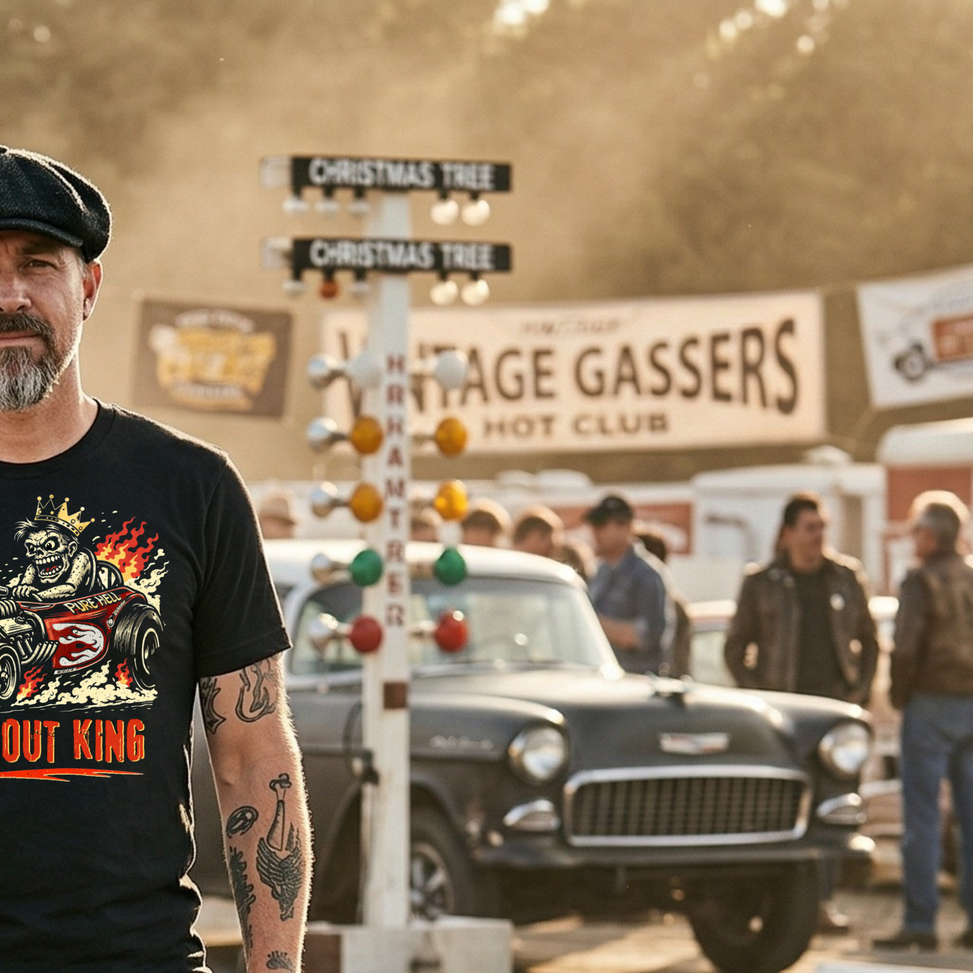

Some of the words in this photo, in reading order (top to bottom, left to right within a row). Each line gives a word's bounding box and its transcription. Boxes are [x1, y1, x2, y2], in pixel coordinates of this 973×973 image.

[308, 158, 435, 188] CHRISTMAS
[442, 163, 495, 190] TREE
[308, 239, 435, 269] CHRISTMAS
[442, 243, 495, 270] TREE
[574, 317, 798, 416] GASSERS
[483, 415, 555, 436] HOT
[573, 413, 669, 436] CLUB
[63, 598, 99, 614] PURE
[94, 591, 122, 607] HELL
[73, 718, 145, 763] KING
